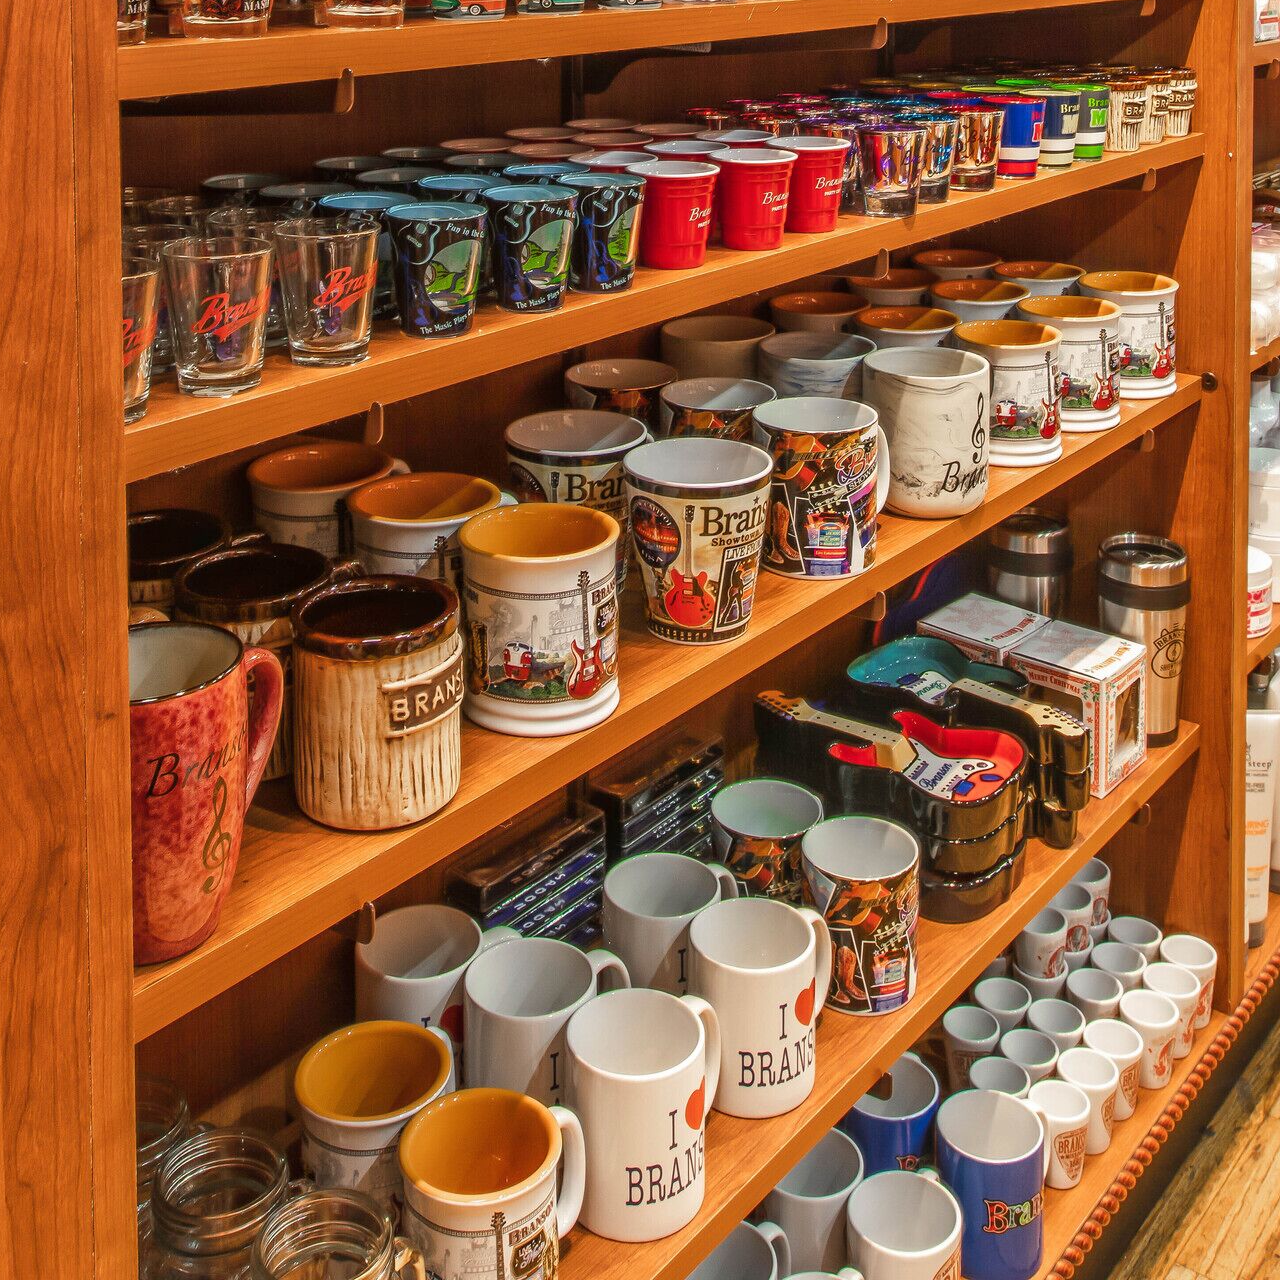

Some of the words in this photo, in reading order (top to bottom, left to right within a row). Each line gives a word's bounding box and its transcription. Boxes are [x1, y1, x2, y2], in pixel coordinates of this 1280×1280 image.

[600, 281, 612, 290] The
[515, 301, 527, 309] The
[529, 296, 546, 307] Music
[420, 326, 433, 335] The
[434, 320, 453, 332] Music
[726, 546, 743, 559] LIVE
[919, 762, 953, 791] Branson
[779, 1002, 788, 1040] I
[669, 1109, 679, 1150] I
